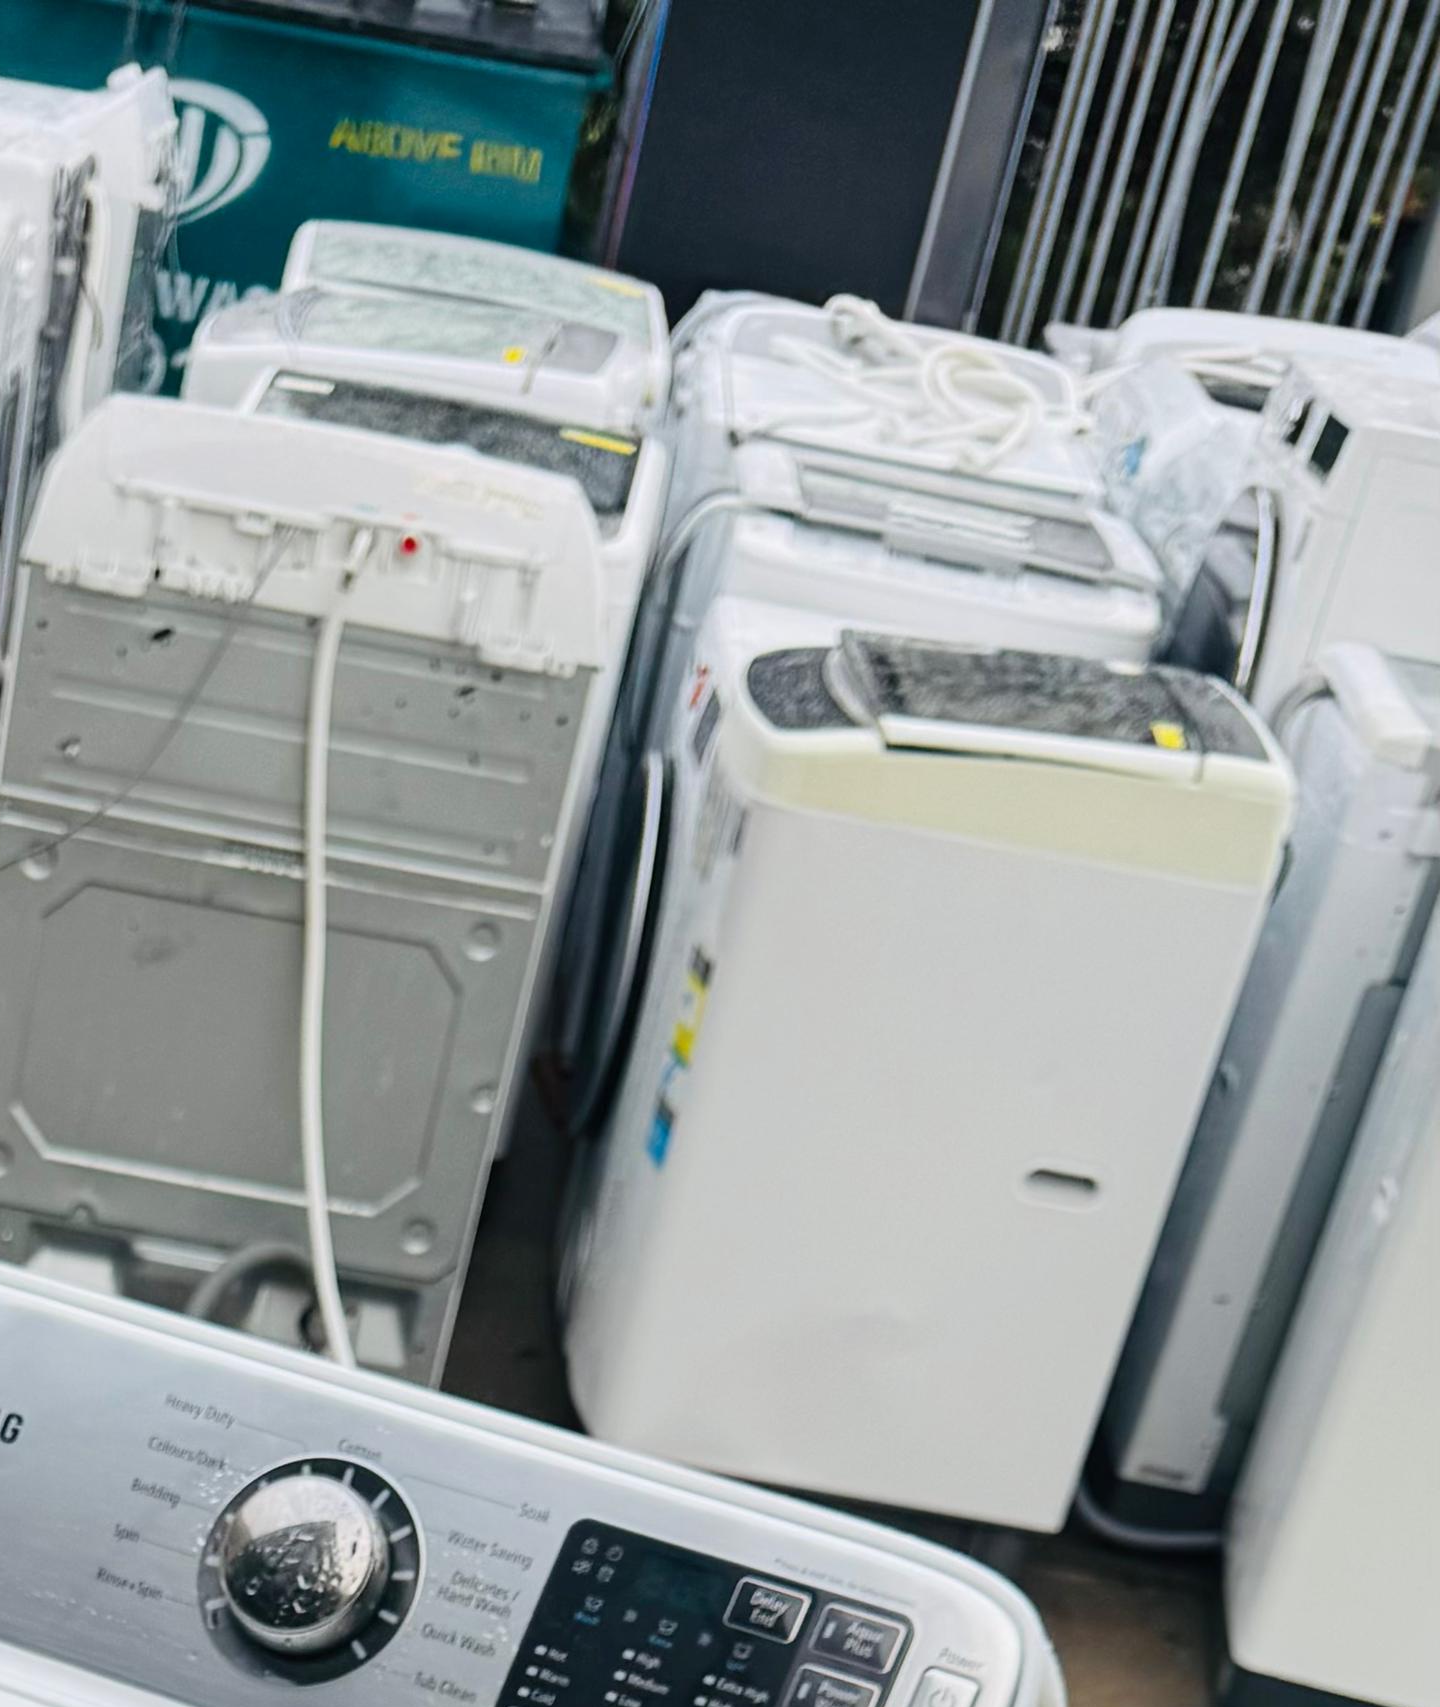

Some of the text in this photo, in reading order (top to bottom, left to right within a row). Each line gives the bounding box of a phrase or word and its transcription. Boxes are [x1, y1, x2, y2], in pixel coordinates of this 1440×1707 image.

[328, 117, 463, 163] ABOVE
[156, 269, 273, 322] WA
[164, 1393, 236, 1428] Heavy Duty
[130, 1477, 182, 1508] Bedding
[113, 1524, 140, 1543] Spin
